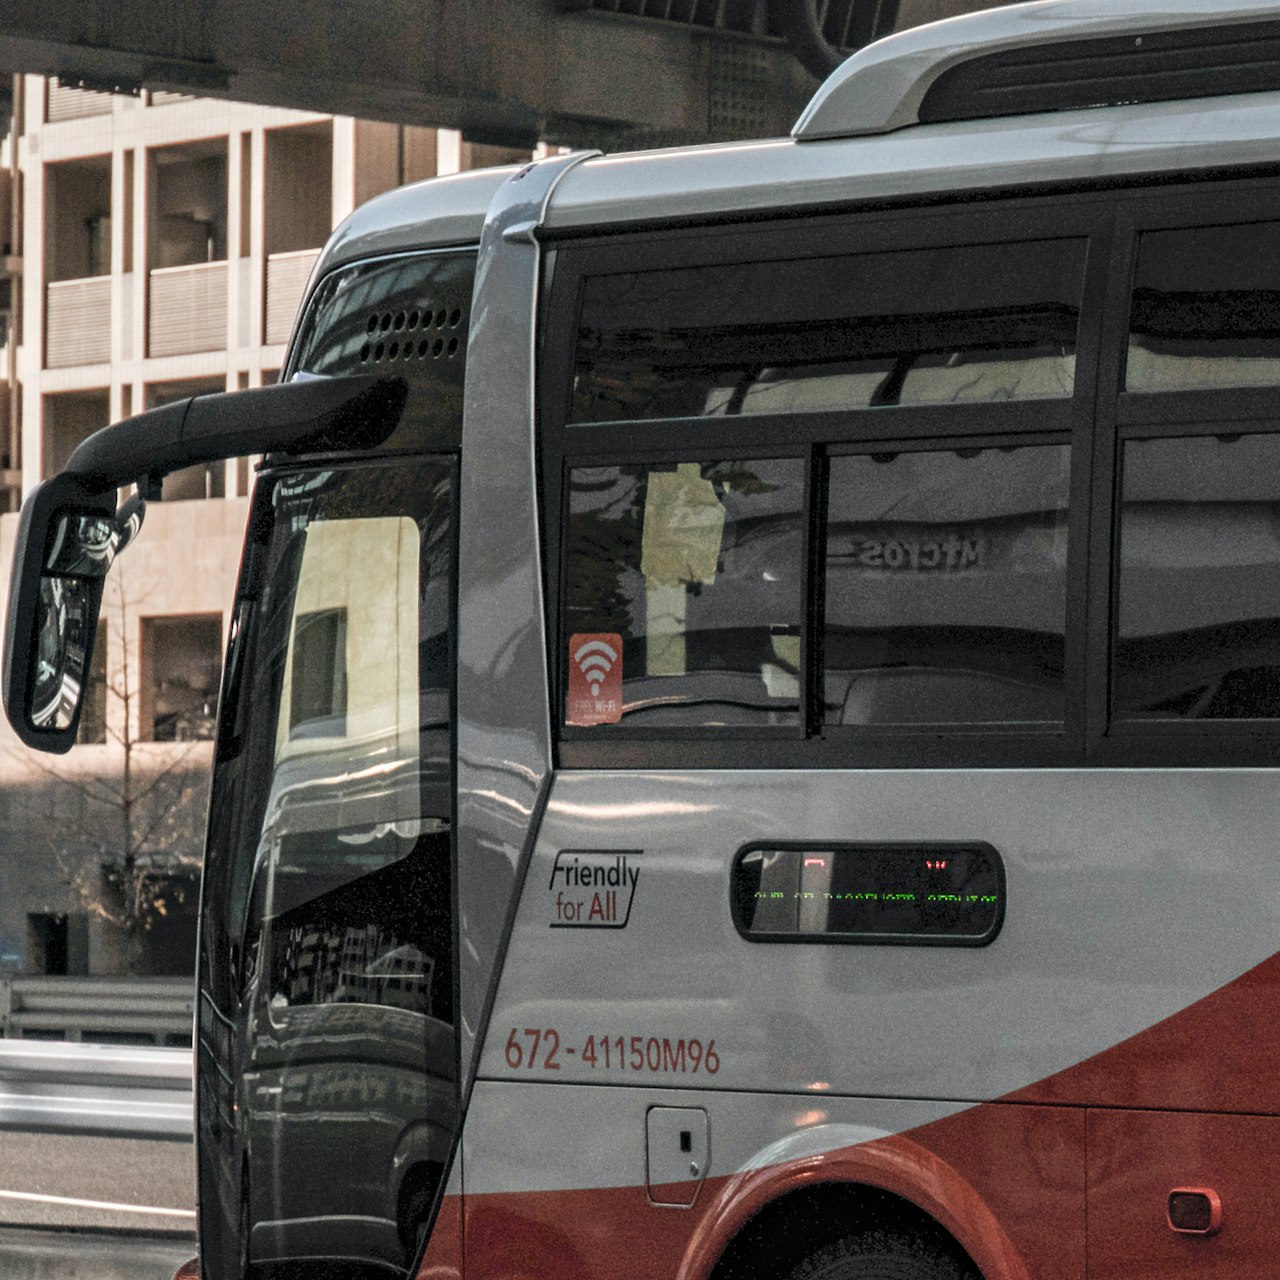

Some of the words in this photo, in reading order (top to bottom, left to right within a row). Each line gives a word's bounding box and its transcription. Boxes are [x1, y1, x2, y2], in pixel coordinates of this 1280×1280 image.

[550, 855, 640, 889] Friendly
[556, 891, 583, 920] for
[588, 890, 617, 921] All
[505, 1028, 720, 1074] 672-41150M96
